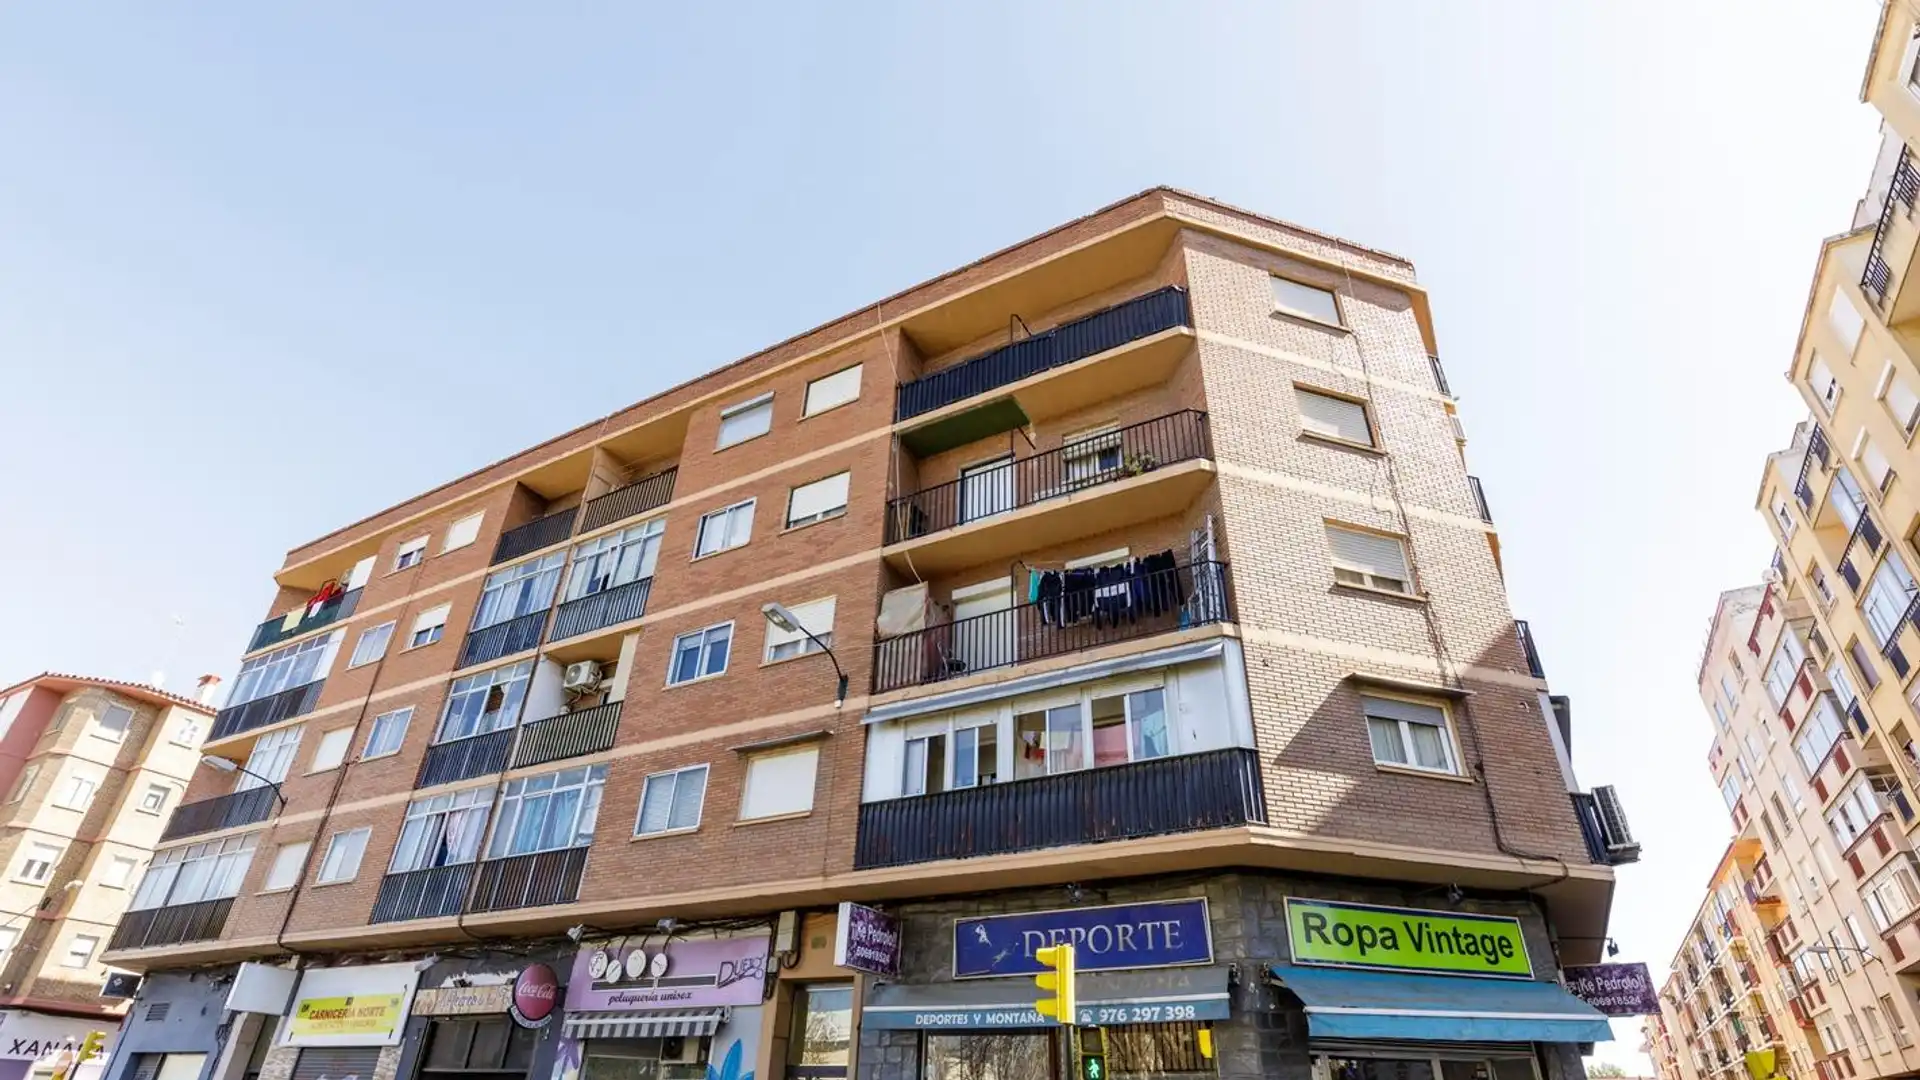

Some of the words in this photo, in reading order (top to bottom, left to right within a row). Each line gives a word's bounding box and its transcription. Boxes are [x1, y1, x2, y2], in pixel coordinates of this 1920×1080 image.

[1022, 919, 1184, 957] DEPORTE
[1302, 911, 1399, 956] Ropa
[1403, 920, 1513, 965] Vintage
[660, 990, 692, 1001] unisex
[357, 1006, 387, 1018] NORTE
[915, 1013, 968, 1025] DEPORTES
[973, 1014, 982, 1025] Y
[985, 1011, 1045, 1024] MONTAÑA
[1099, 1008, 1127, 1022] 976
[1132, 1007, 1160, 1021] 297
[1165, 1005, 1196, 1020] 398
